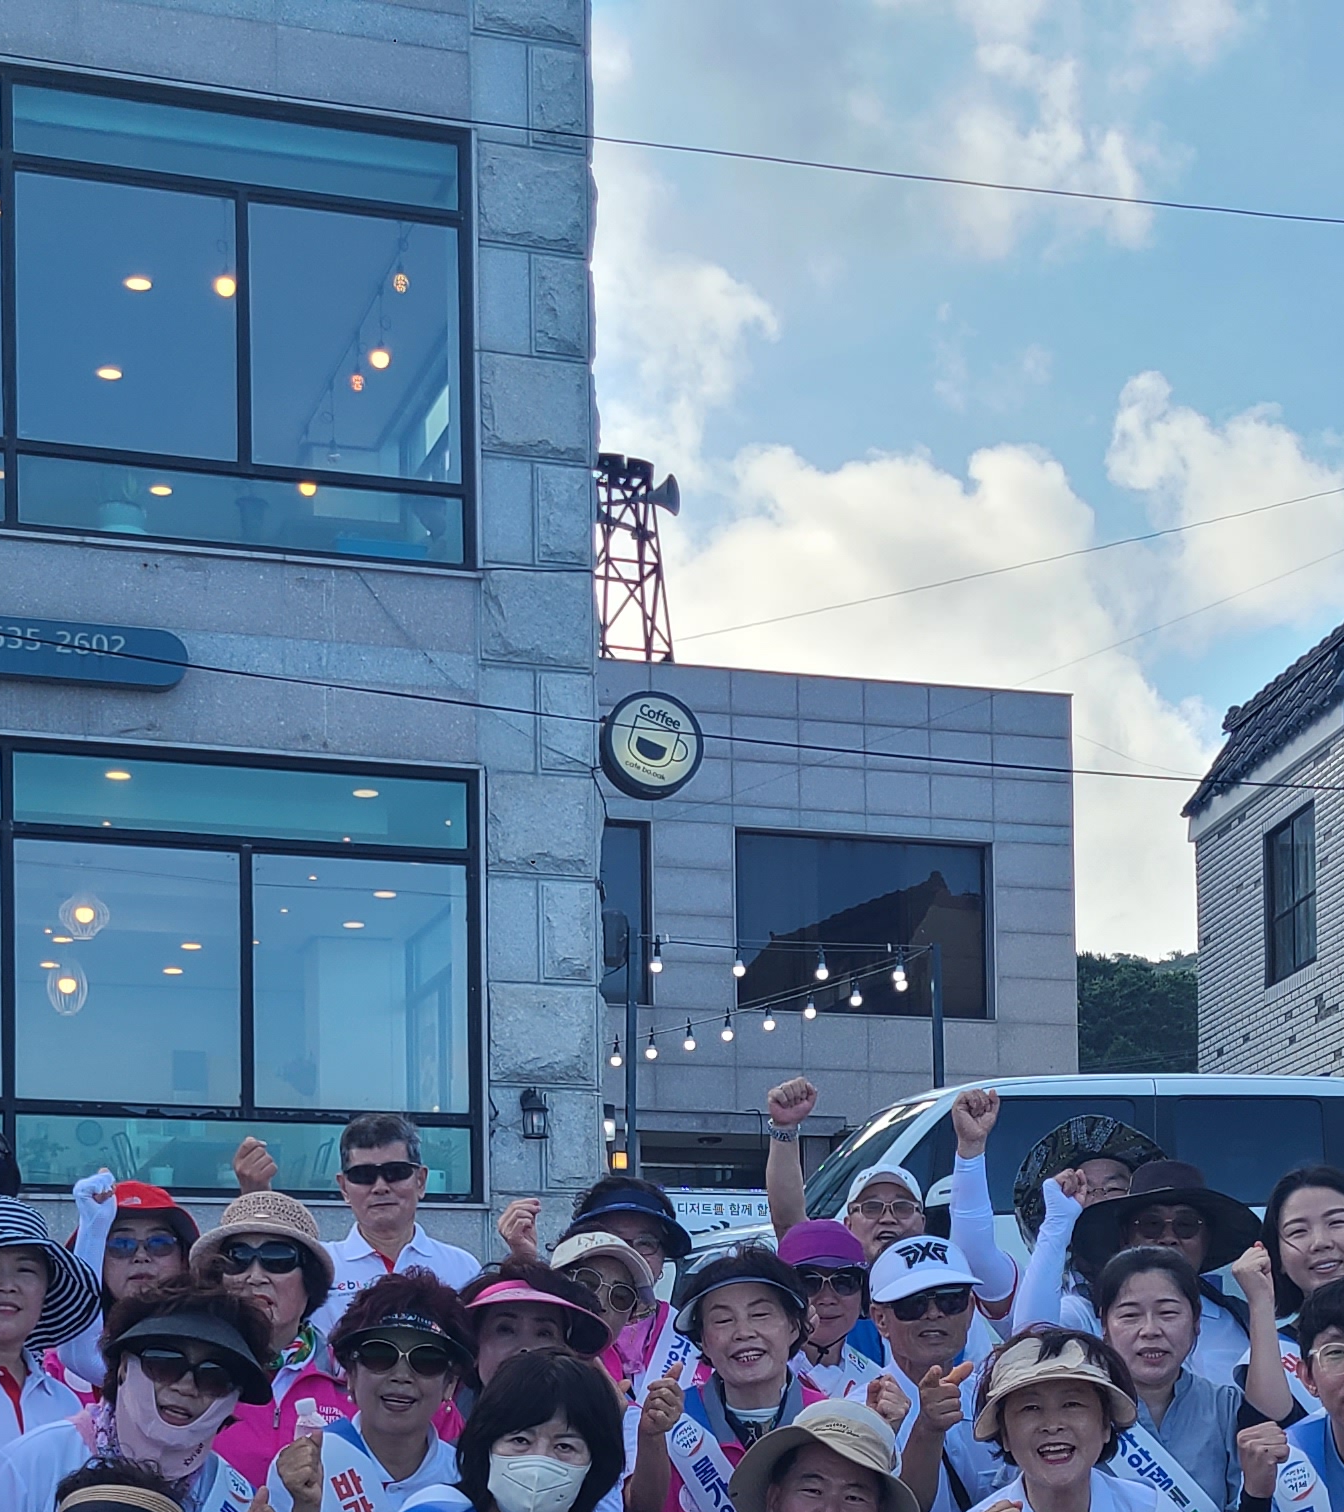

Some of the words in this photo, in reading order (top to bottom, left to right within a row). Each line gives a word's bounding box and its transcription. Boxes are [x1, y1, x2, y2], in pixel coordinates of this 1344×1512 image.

[639, 703, 681, 730] Coffee
[625, 760, 641, 772] cafe
[729, 1203, 753, 1216] 함께
[896, 1241, 948, 1269] PXG
